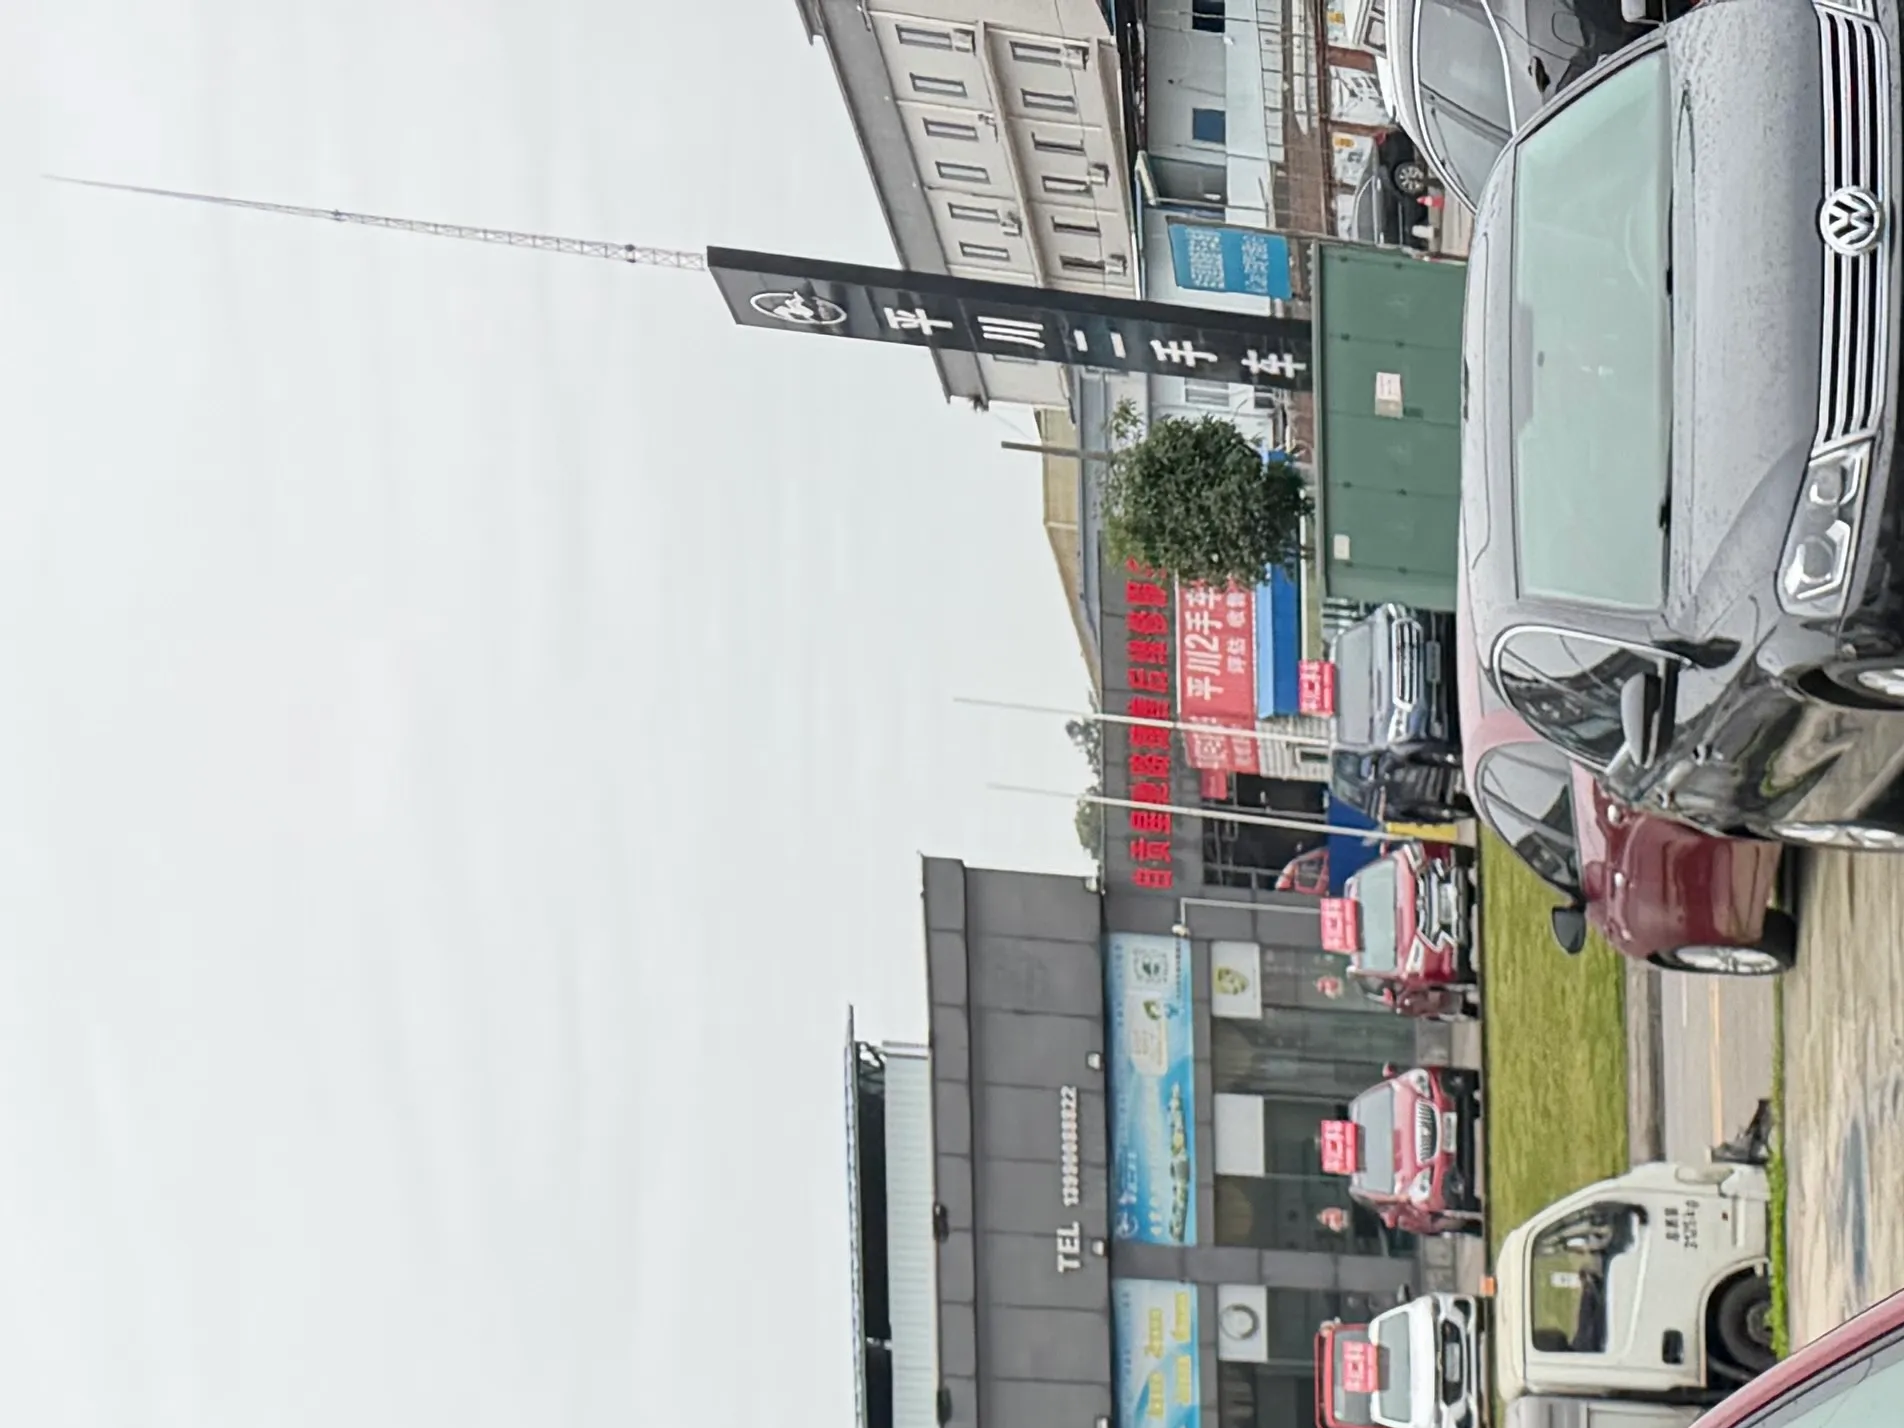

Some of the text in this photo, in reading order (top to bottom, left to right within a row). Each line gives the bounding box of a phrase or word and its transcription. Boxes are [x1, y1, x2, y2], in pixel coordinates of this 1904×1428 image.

[881, 305, 1308, 379] 平川二手车
[1184, 586, 1225, 701] 平川2手车
[1056, 1221, 1081, 1273] TEL
